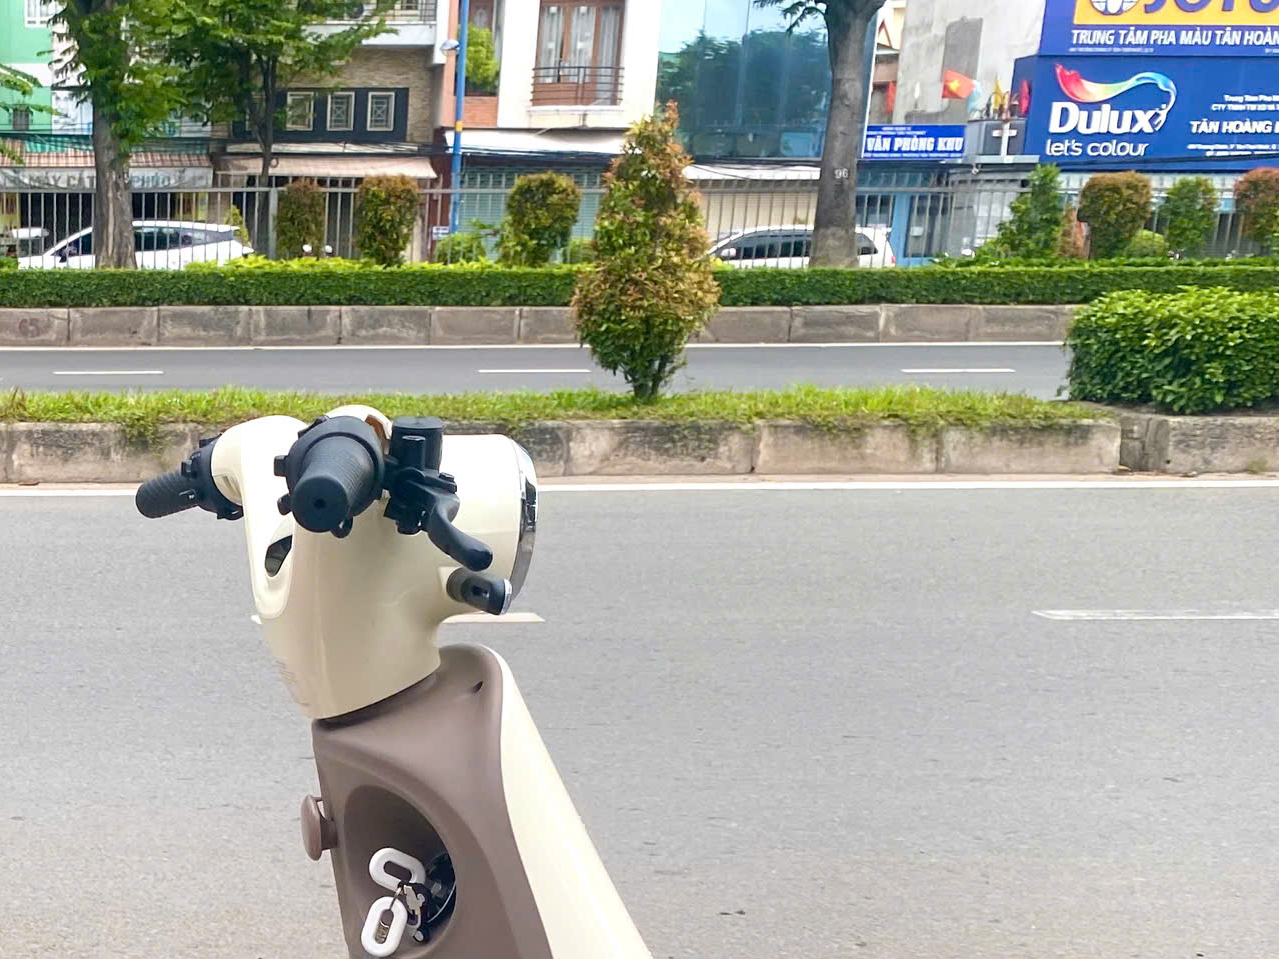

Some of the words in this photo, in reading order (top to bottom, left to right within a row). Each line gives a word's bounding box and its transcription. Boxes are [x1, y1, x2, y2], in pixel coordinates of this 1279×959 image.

[1072, 30, 1114, 45] TRUNG
[1119, 27, 1148, 45] TÂM
[1151, 30, 1175, 45] PHA
[1179, 27, 1212, 45] MÀU
[1215, 27, 1242, 45] TÂN
[1049, 102, 1154, 134] Dulux
[1190, 118, 1220, 133] TÂN
[1222, 118, 1272, 133] HOÀNG
[893, 135, 935, 151] PHÒNG
[937, 137, 964, 151] KHU
[1046, 139, 1083, 156] let's
[1087, 139, 1149, 156] colour
[834, 168, 849, 179] 96
